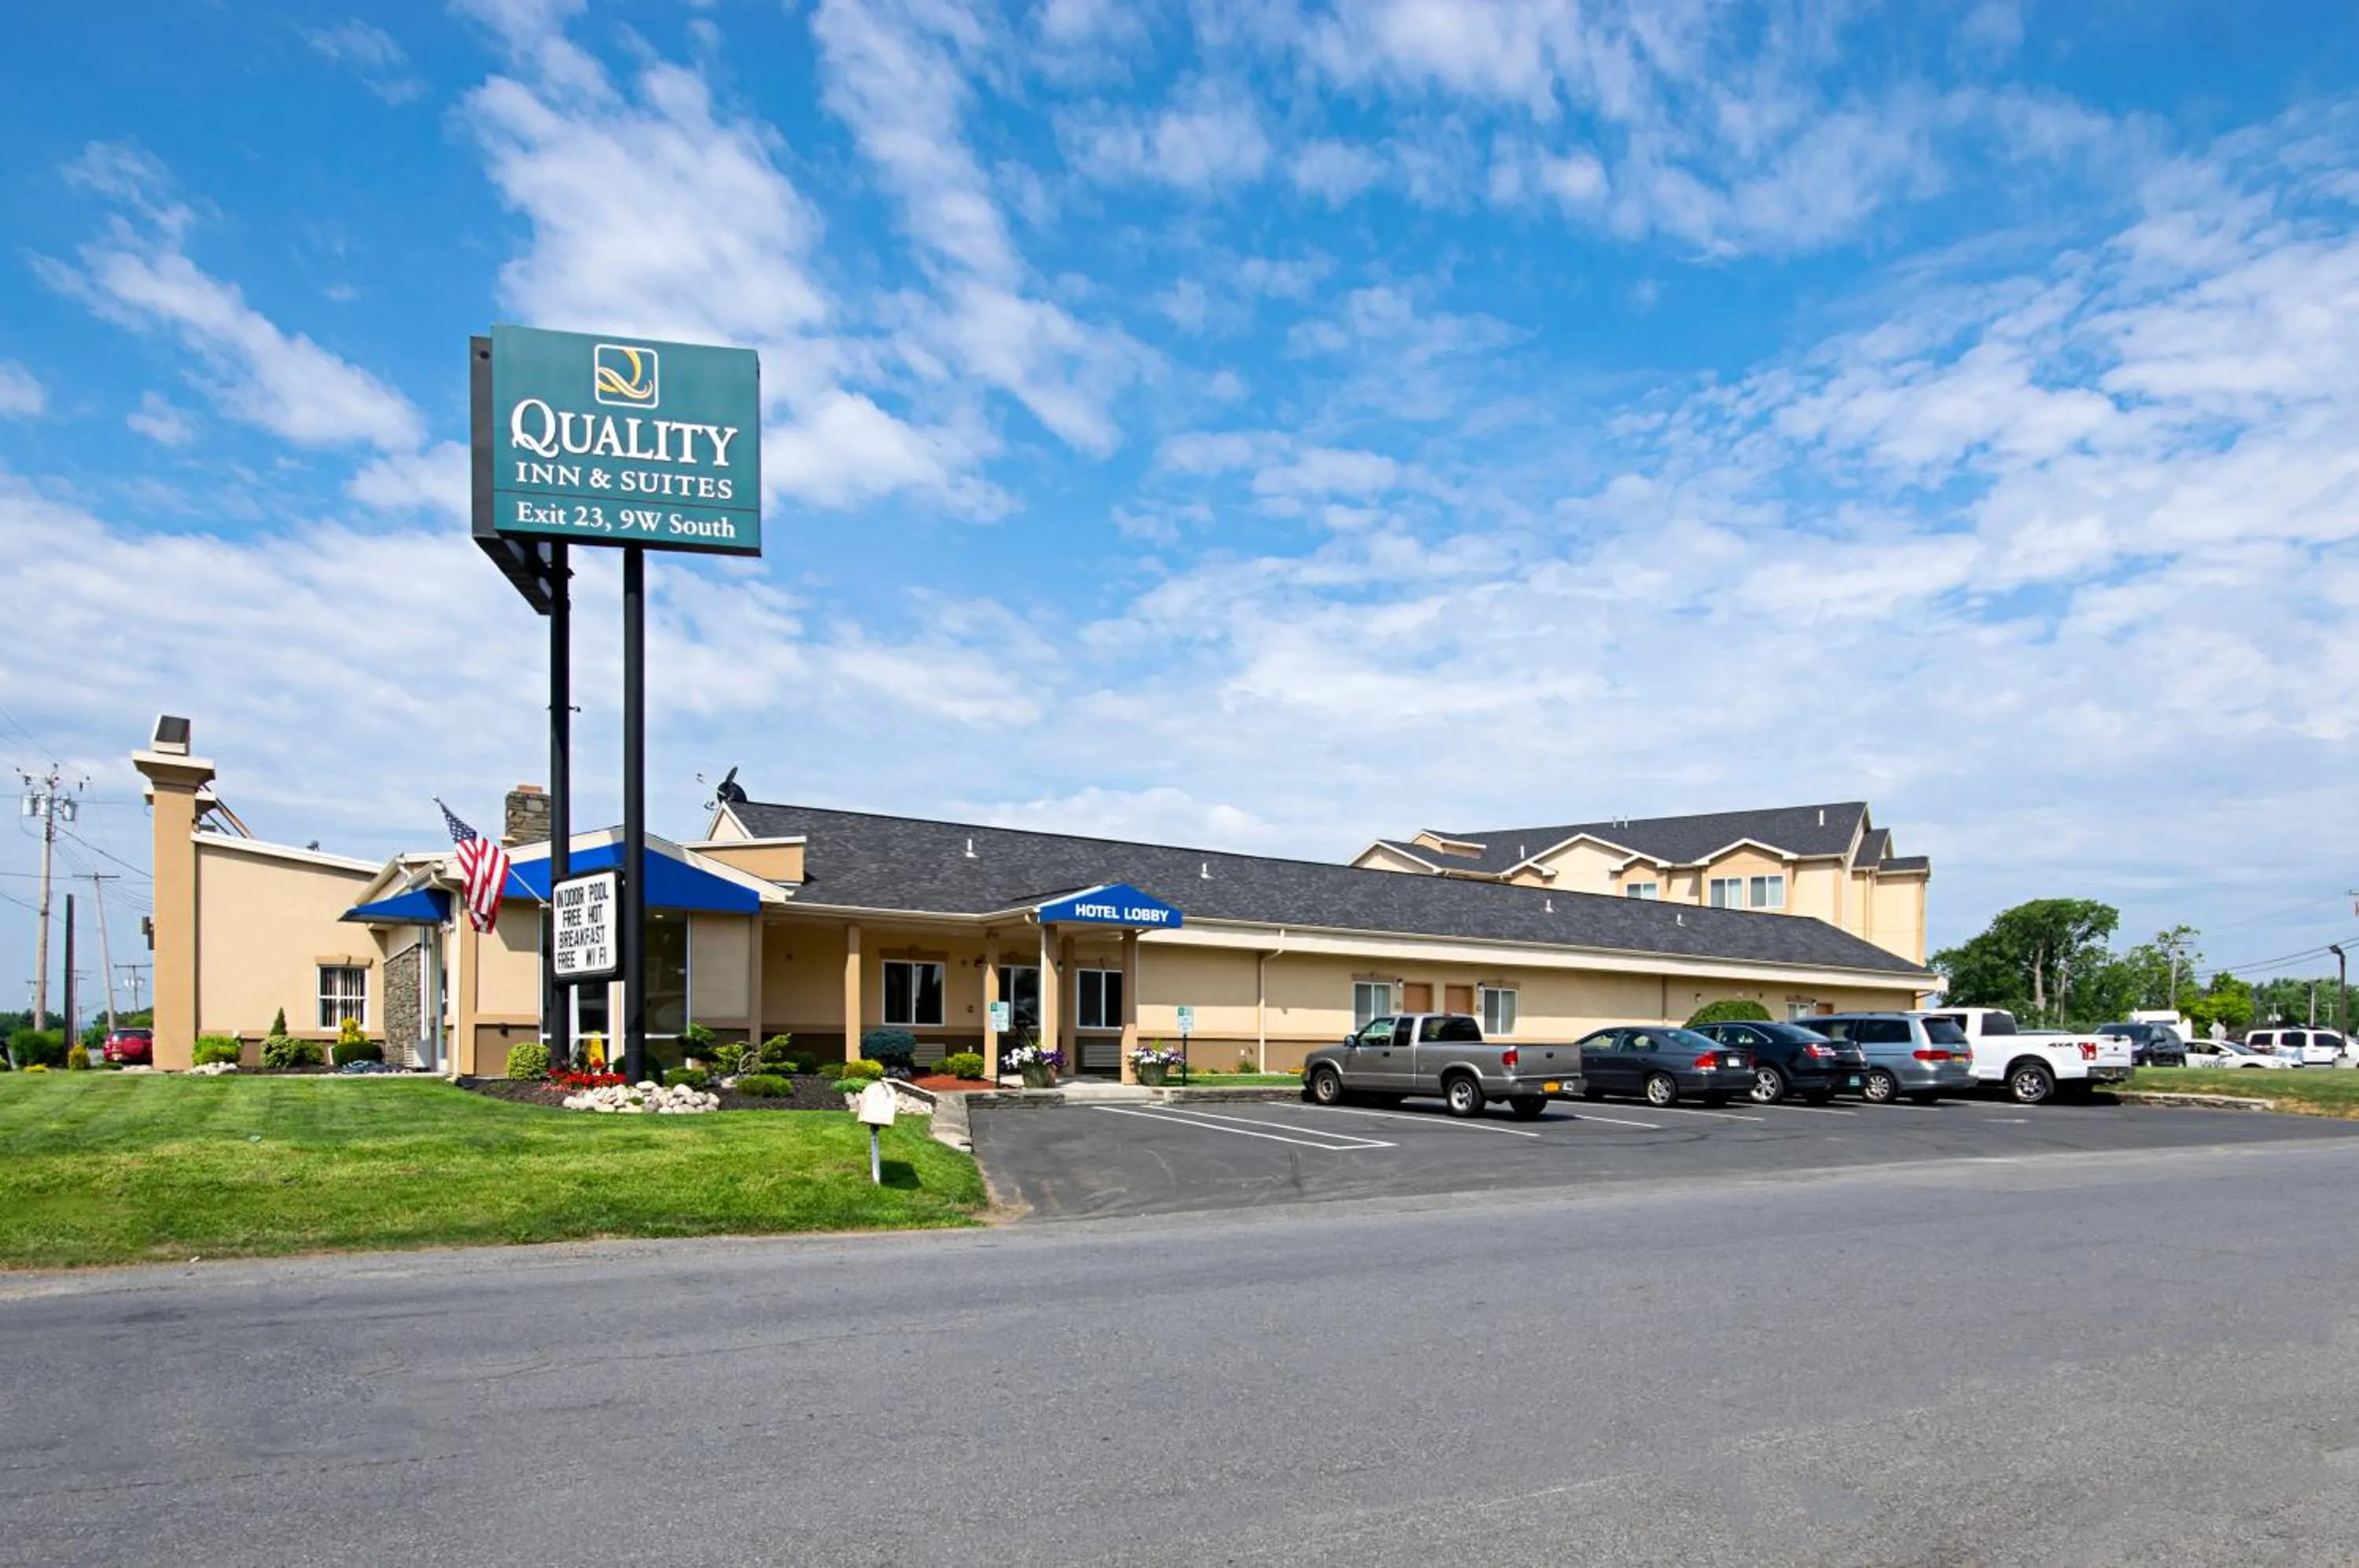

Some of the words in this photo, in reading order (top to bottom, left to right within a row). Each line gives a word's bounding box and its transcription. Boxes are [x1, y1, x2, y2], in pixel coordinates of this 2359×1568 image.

[511, 398, 738, 466] QUALITY
[516, 462, 580, 486] INN
[591, 467, 612, 489] &
[620, 470, 733, 499] SUITES
[516, 501, 566, 525] Exit
[573, 506, 613, 532] 23,
[620, 510, 662, 532] 9W
[669, 513, 736, 538] South
[556, 886, 584, 908] INDOOR
[588, 881, 609, 902] POOL
[562, 907, 582, 927] FREE
[587, 904, 603, 924] HOT
[1075, 903, 1120, 919] HOTEL
[1124, 907, 1169, 922] LOBBY
[558, 924, 605, 949] BREAKFAST
[558, 951, 576, 970] FREE
